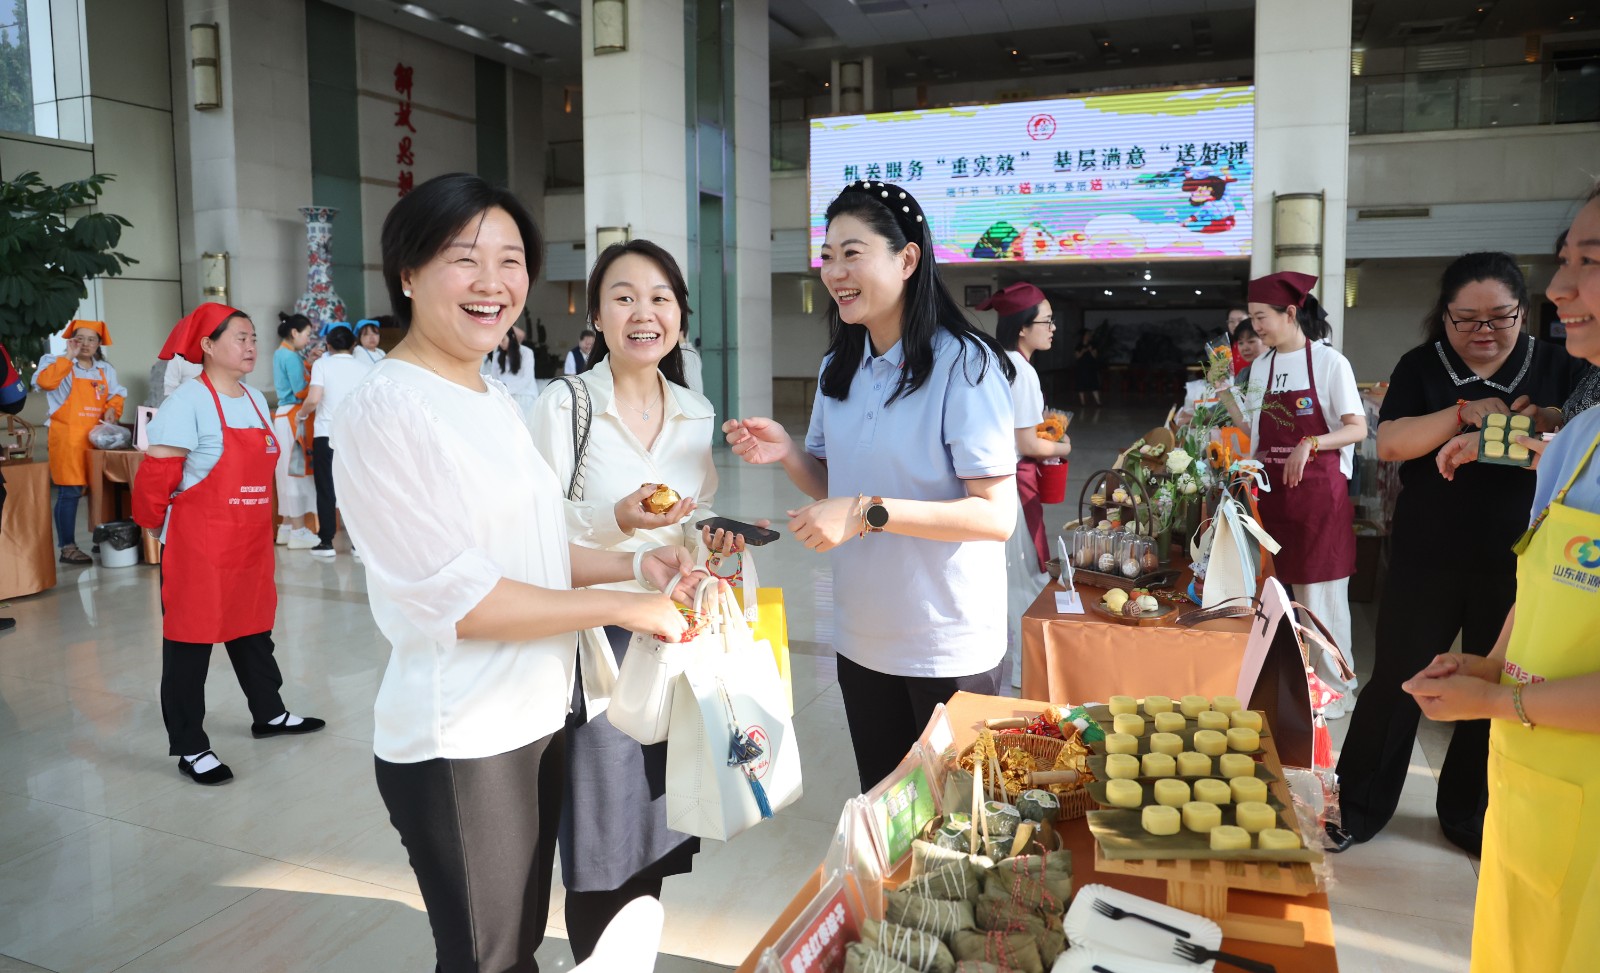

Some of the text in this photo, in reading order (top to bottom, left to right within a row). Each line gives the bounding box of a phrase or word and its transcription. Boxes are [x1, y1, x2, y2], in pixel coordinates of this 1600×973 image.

[1275, 373, 1289, 388] YT
[1553, 564, 1600, 588] 山东能源
